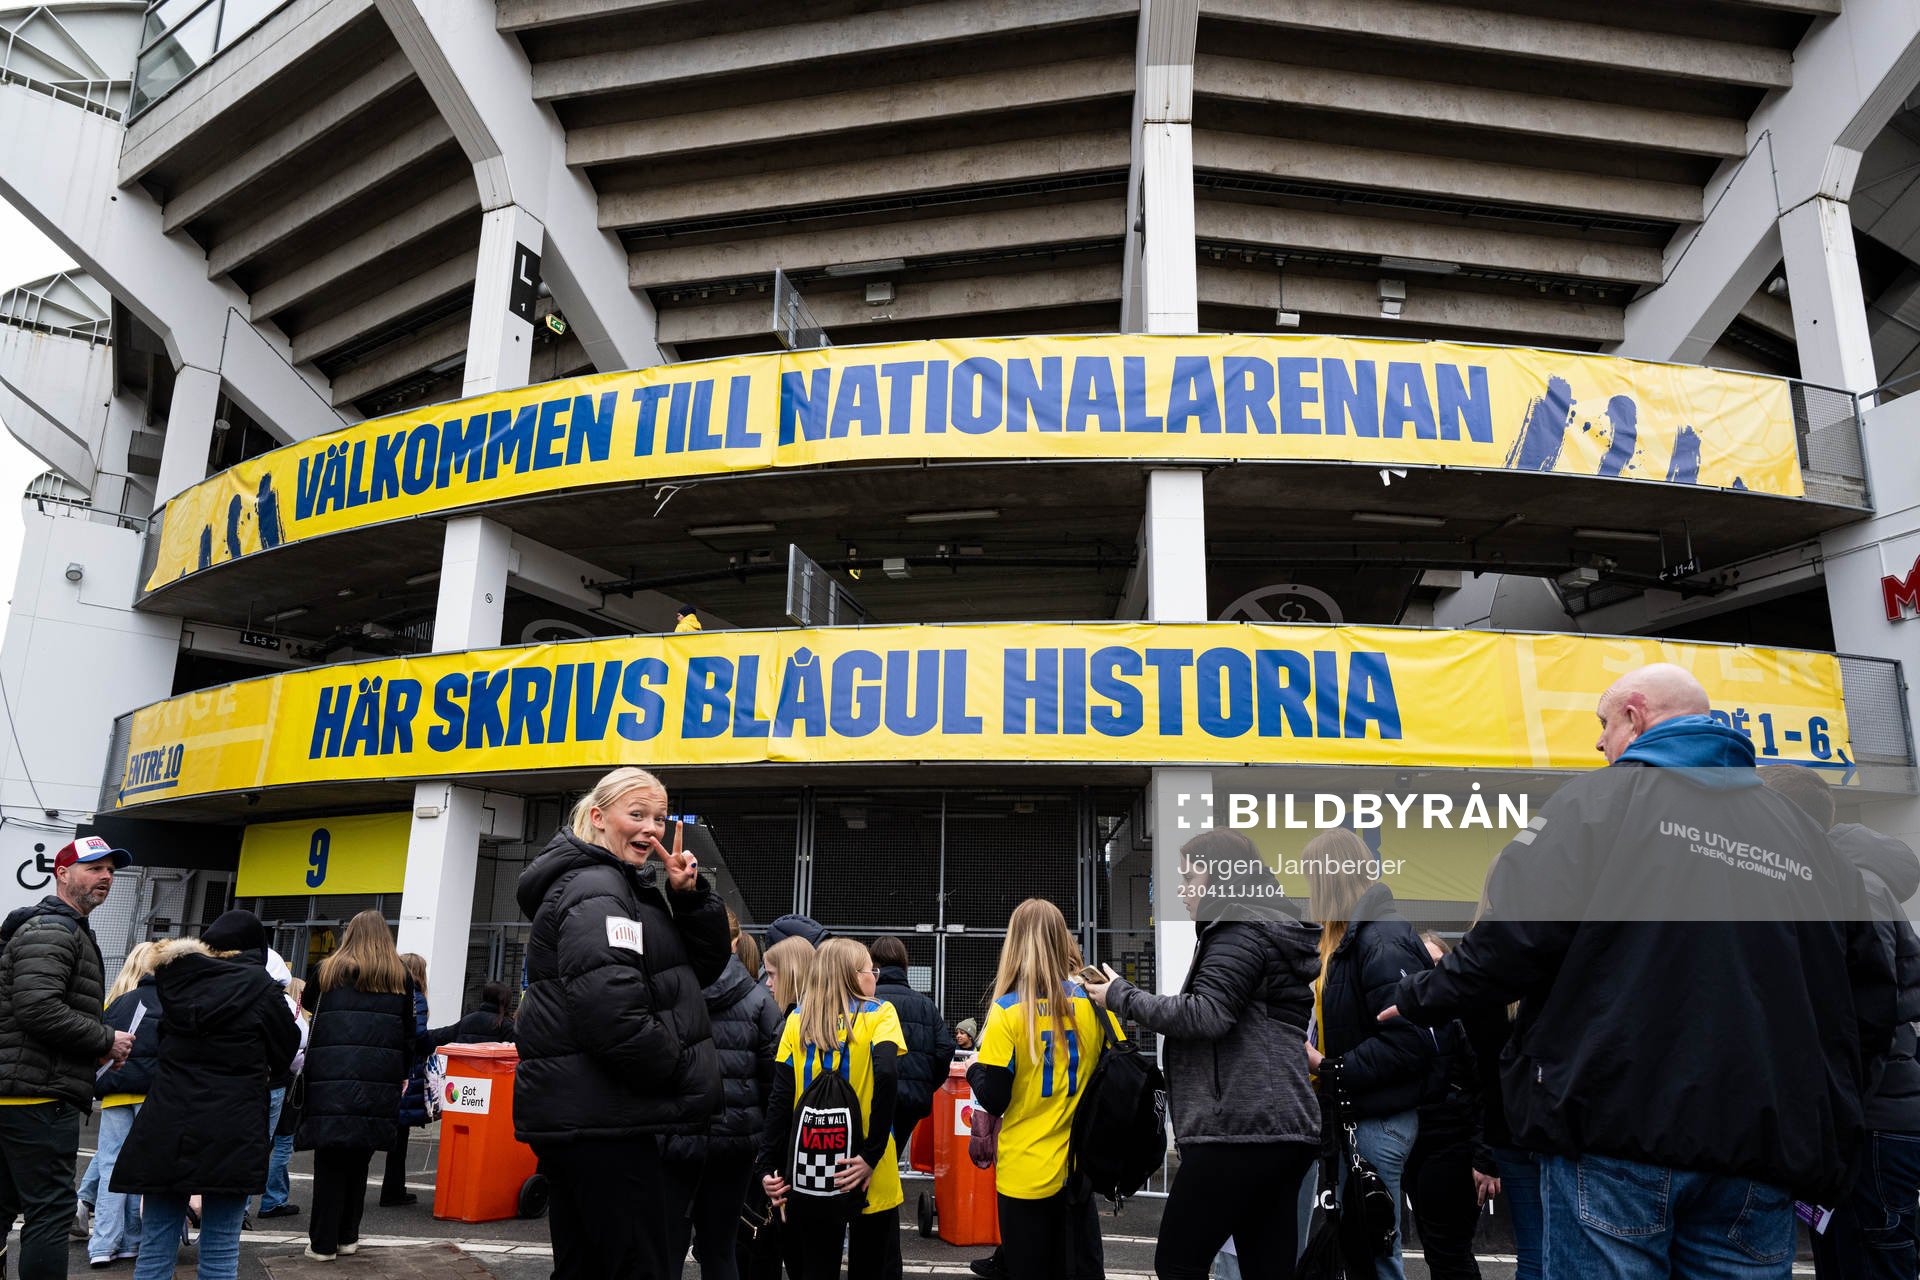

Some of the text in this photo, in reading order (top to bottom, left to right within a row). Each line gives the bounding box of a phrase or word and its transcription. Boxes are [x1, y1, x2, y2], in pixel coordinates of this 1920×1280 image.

[520, 254, 533, 286] L
[520, 303, 526, 312] 1
[295, 356, 1494, 521] VÄLKOMMEN TILL NATIONALARENAN
[309, 646, 1402, 760] HÄR SKRIVS BLÅGUL HISTORIA
[127, 743, 185, 787] ENTRÉ 10
[306, 828, 331, 888] 9
[1659, 821, 1813, 881] UNG UTVECKLING
[1736, 859, 1787, 881] KOMMUN
[1041, 1029, 1079, 1097] 11
[461, 1096, 484, 1107] Event
[462, 1085, 477, 1096] Got
[815, 1116, 826, 1126] THE
[828, 1115, 846, 1125] WALL
[802, 1126, 846, 1150] VANS
